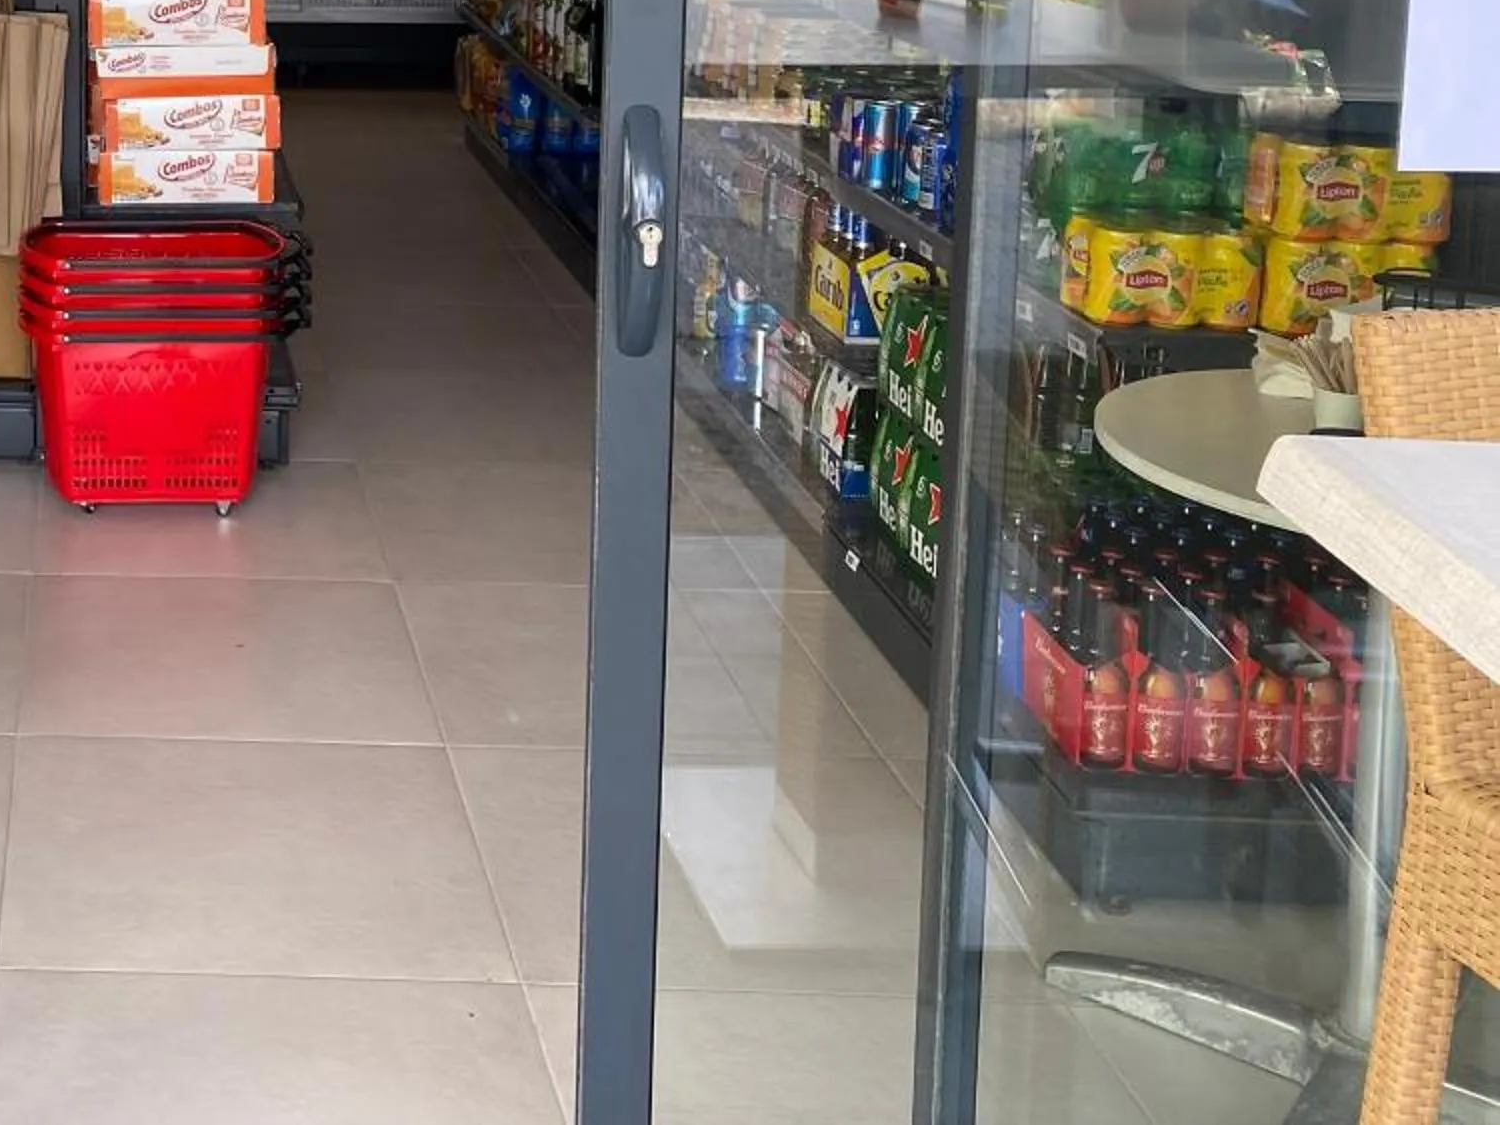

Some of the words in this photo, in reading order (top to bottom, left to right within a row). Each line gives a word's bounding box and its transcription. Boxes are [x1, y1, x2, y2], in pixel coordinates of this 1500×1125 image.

[169, 99, 220, 124] Combos
[163, 153, 211, 176] Combos
[1320, 185, 1357, 199] Lipton
[1129, 274, 1165, 287] Lipton
